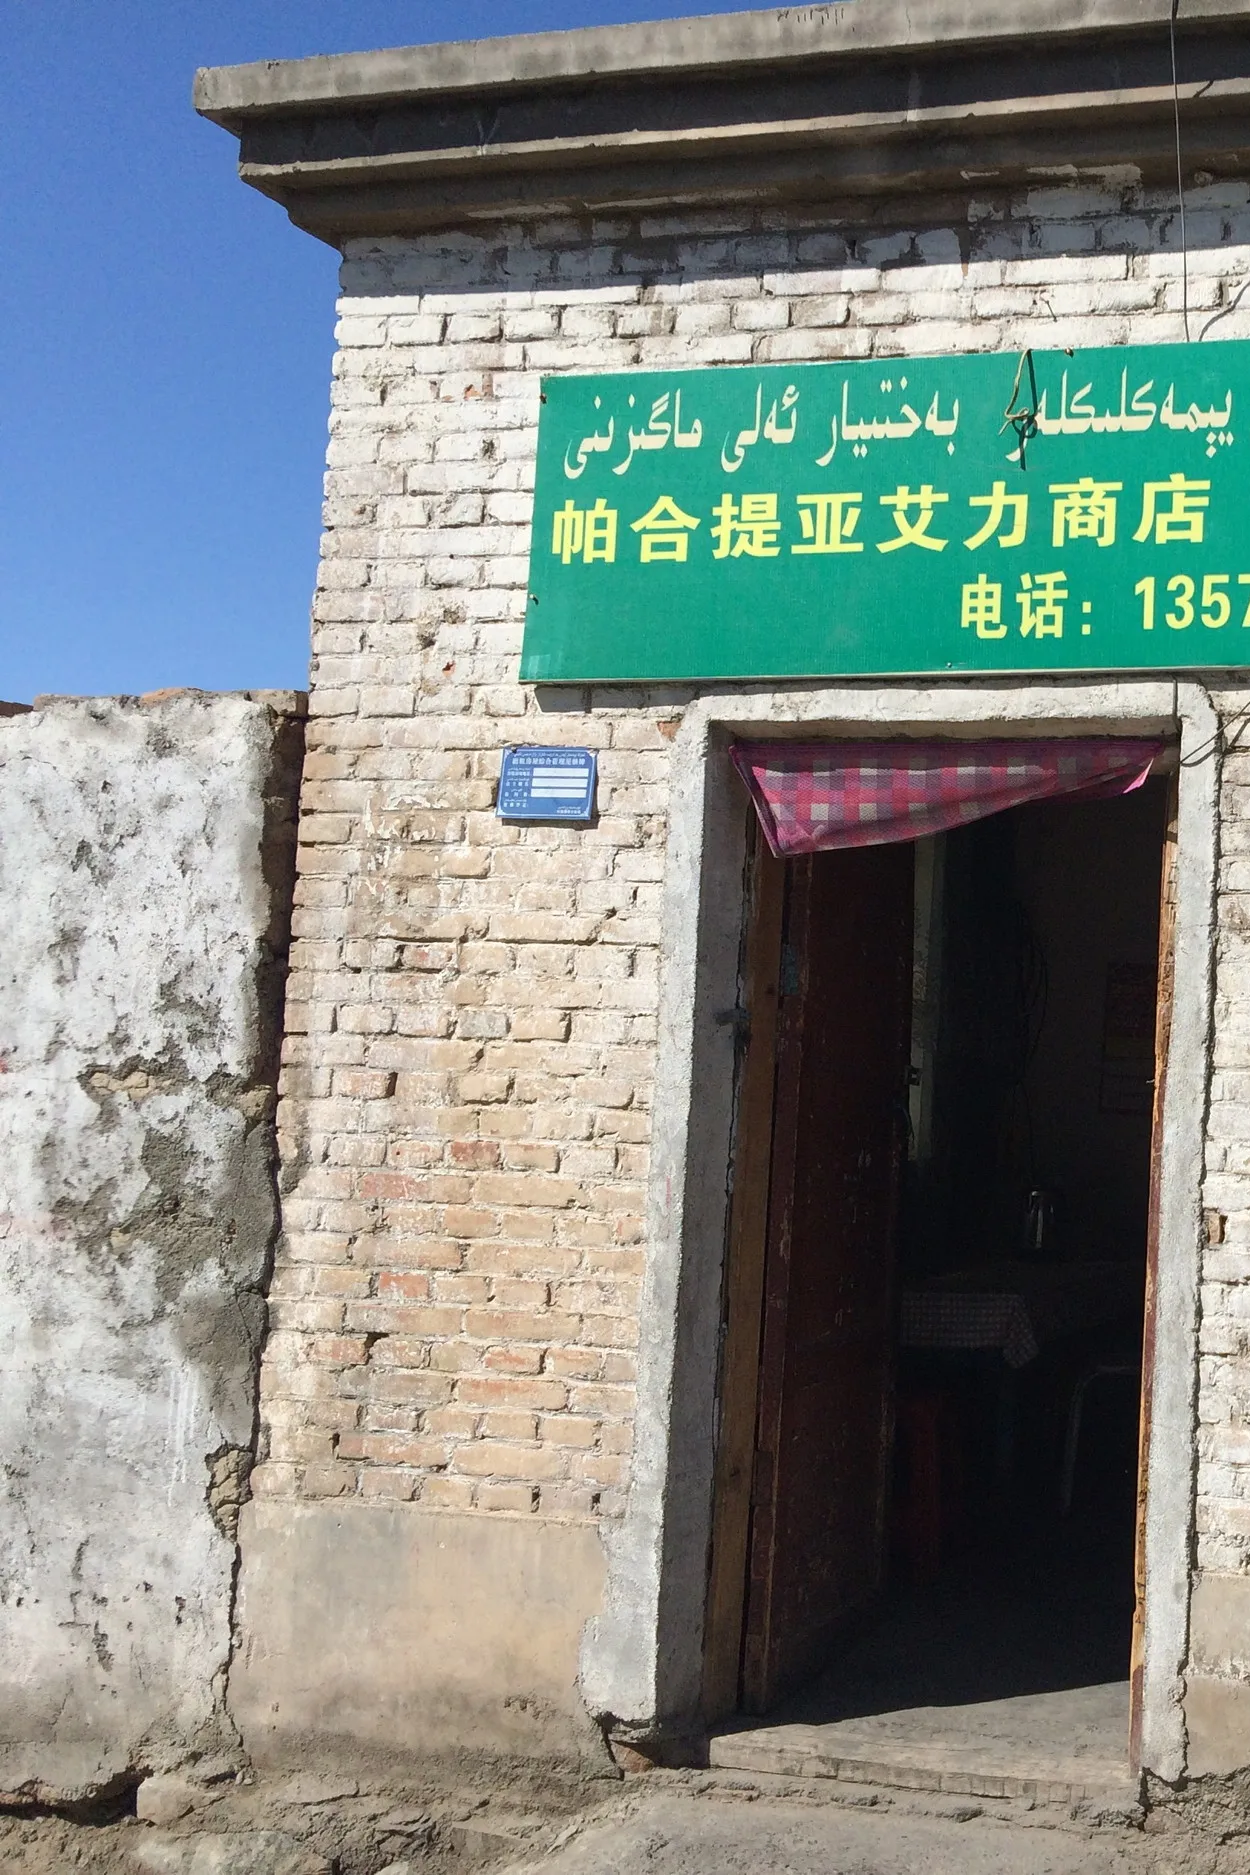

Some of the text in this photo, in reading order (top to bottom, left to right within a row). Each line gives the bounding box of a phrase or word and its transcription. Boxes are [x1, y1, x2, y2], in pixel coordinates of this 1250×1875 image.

[551, 472, 1212, 565] 帕合提亚艾力商店
